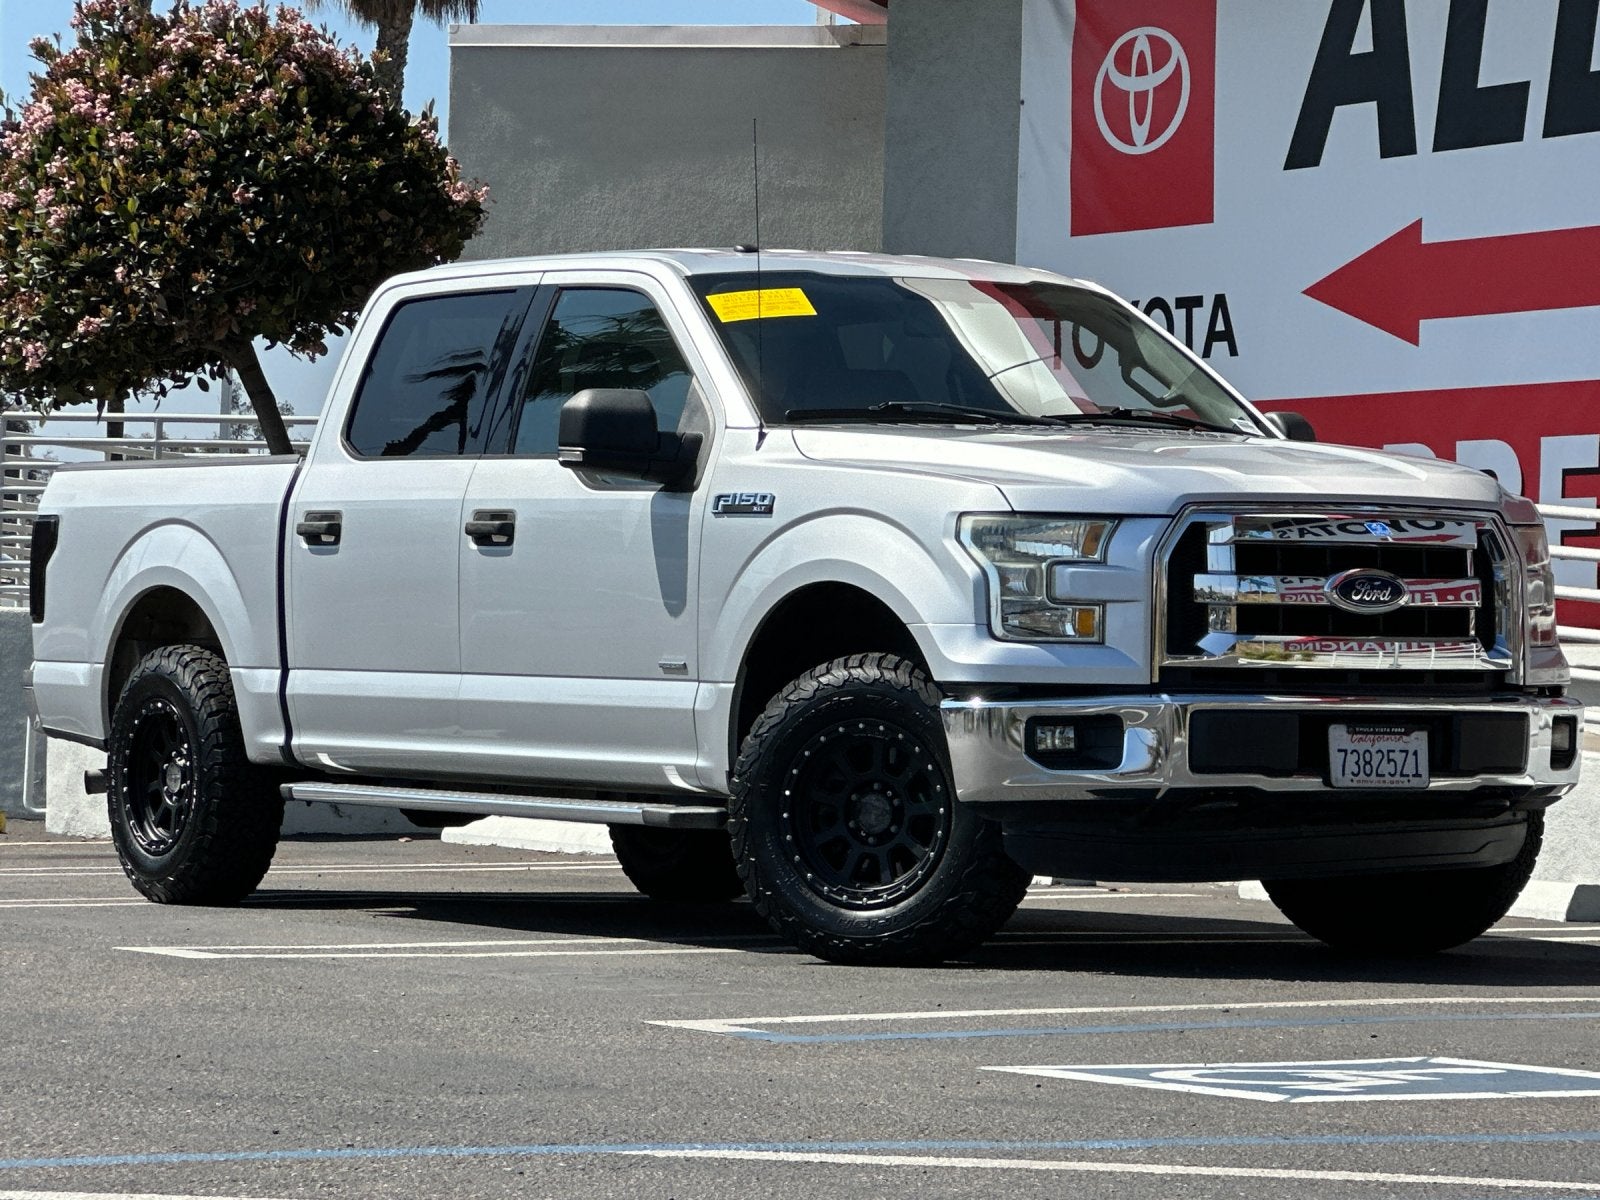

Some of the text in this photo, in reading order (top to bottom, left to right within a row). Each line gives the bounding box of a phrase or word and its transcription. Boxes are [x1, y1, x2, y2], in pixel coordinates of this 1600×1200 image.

[712, 493, 773, 512] F150
[1350, 578, 1392, 601] Ford
[1337, 749, 1422, 778] 73825Z1
